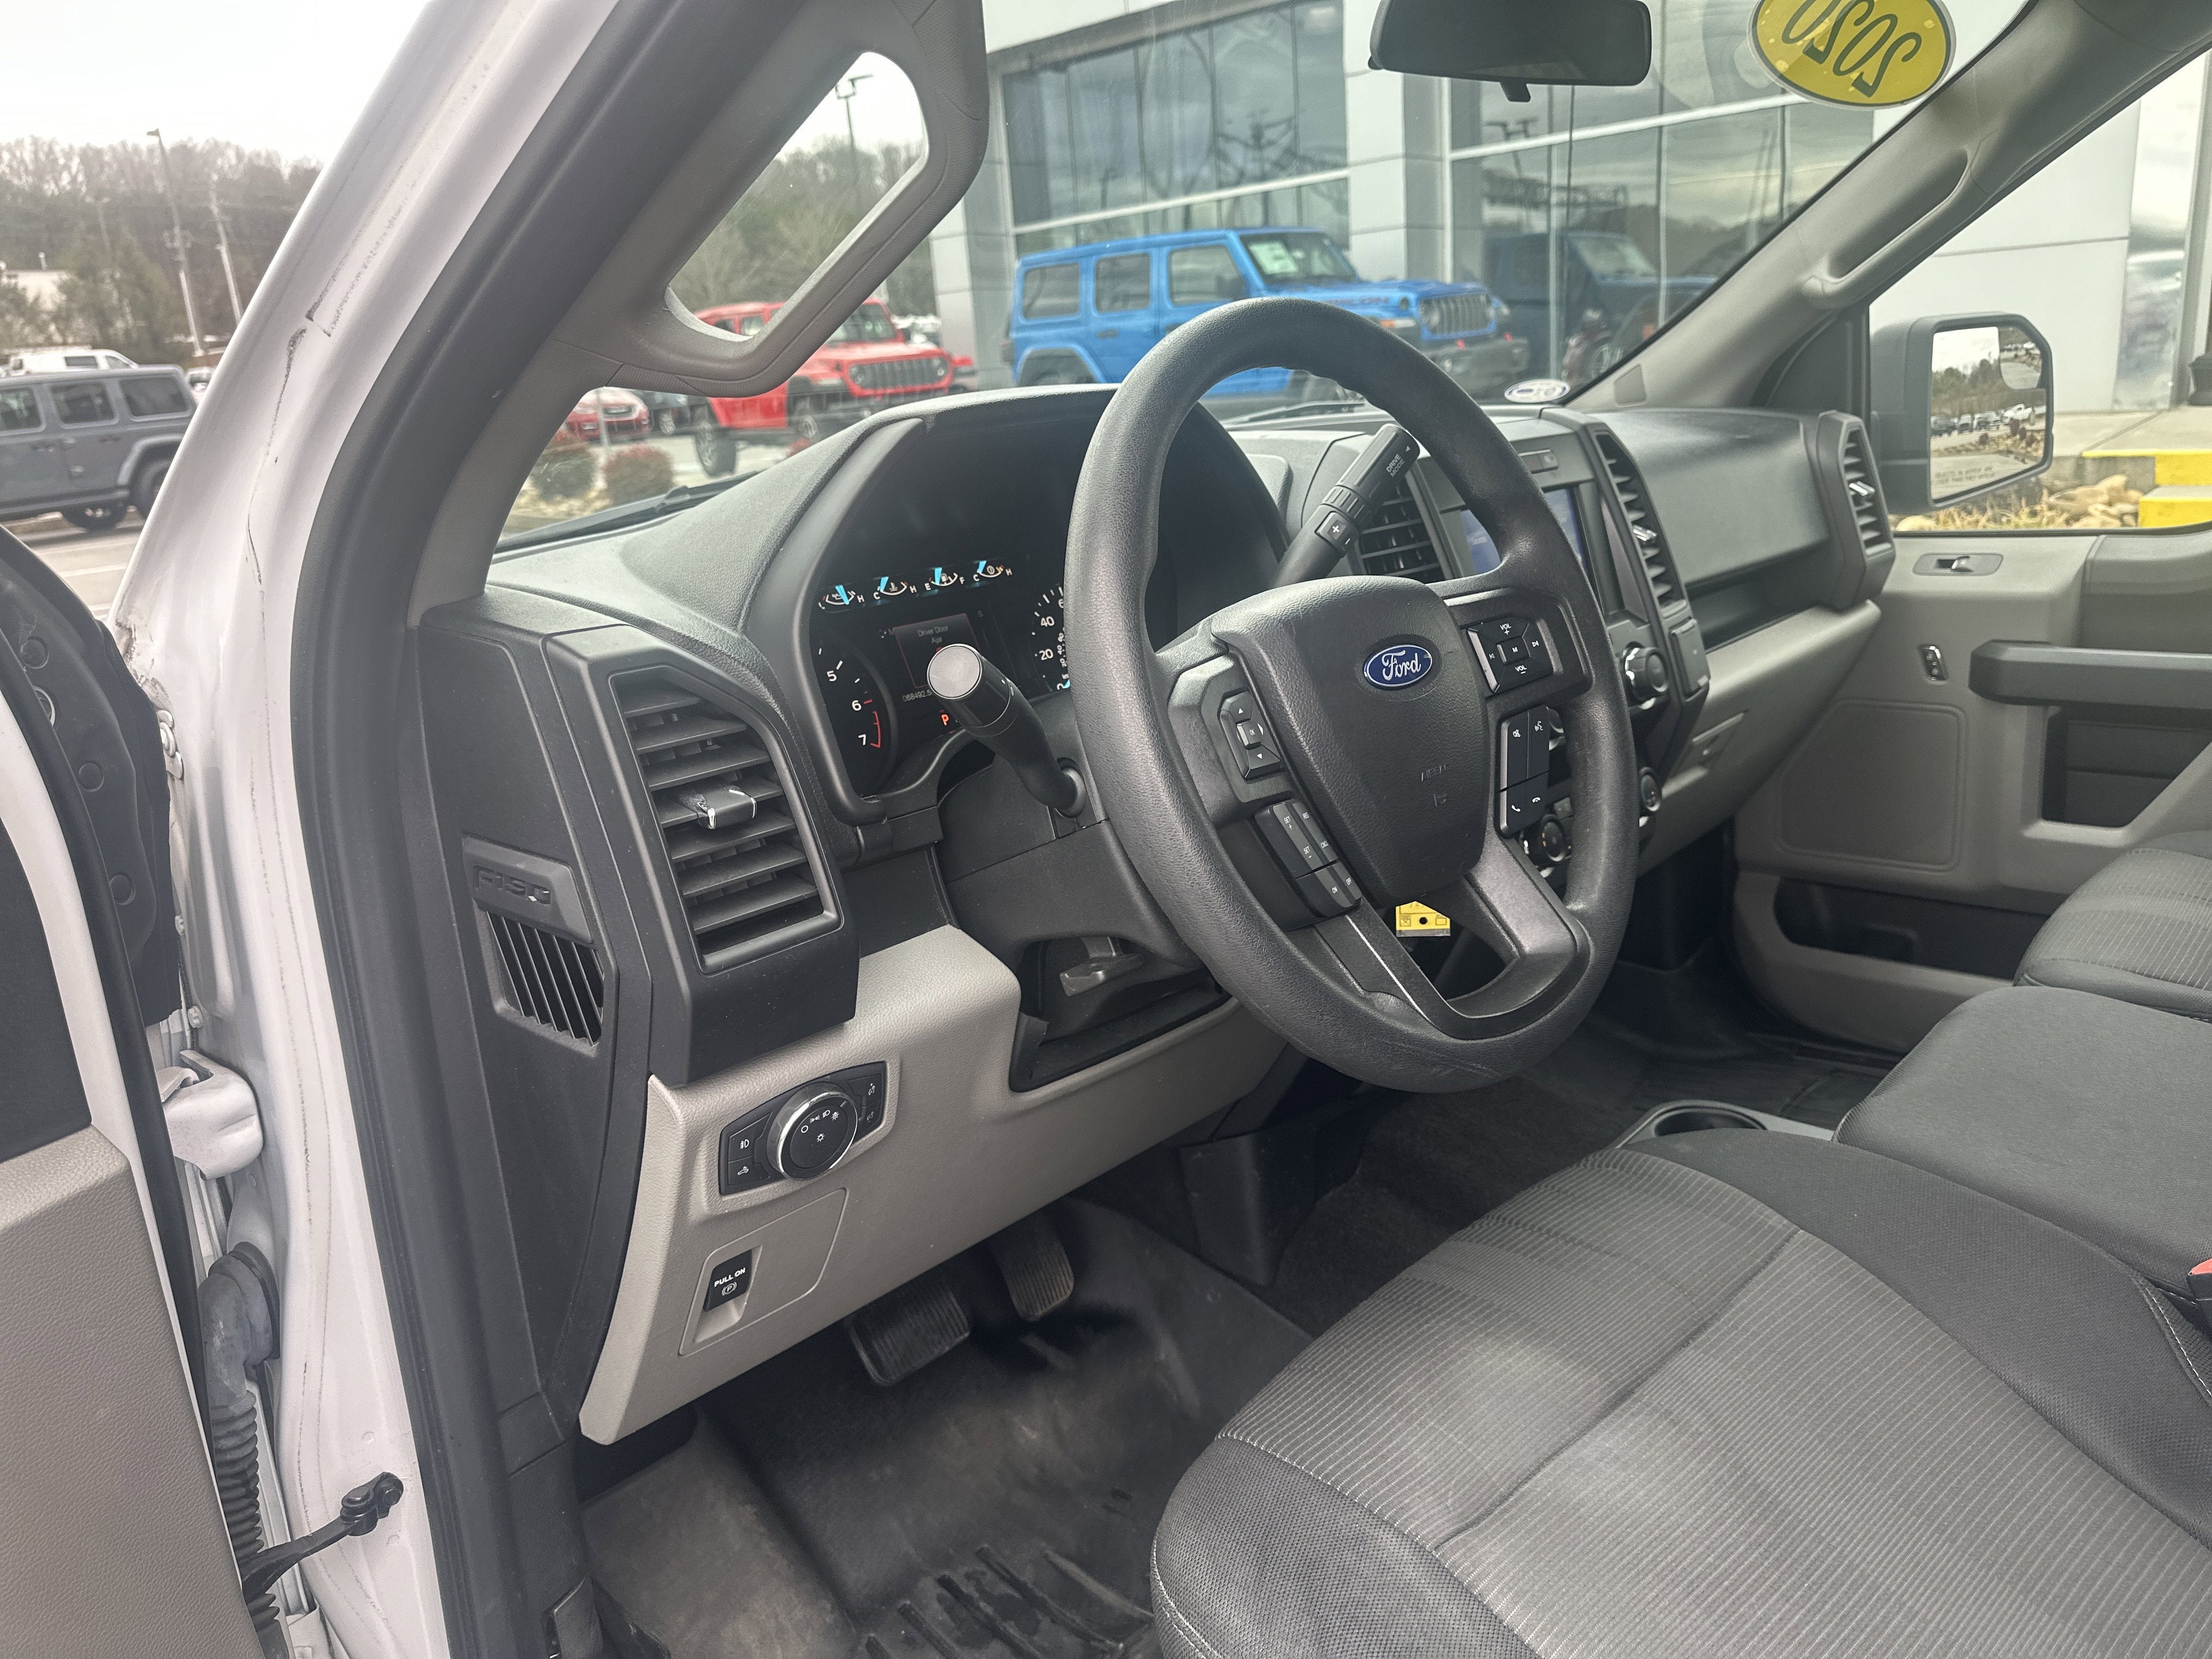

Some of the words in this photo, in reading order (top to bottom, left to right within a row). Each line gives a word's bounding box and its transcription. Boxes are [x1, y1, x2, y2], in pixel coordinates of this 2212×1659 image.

[1386, 453, 1402, 473] DRIVE
[1390, 458, 1406, 477] MODE
[909, 585, 917, 594] H
[924, 583, 932, 591] E
[960, 577, 965, 585] F
[857, 594, 865, 603] H
[1058, 599, 1064, 608] 6
[1041, 616, 1055, 627] 40
[934, 625, 949, 634] Door
[1039, 648, 1054, 661] 20
[1381, 650, 1421, 681] Ford
[826, 670, 837, 681] 5
[851, 699, 862, 711] 6
[941, 714, 949, 726] P
[858, 733, 866, 746] 7
[714, 1274, 733, 1288] PULL
[734, 1267, 746, 1277] ON
